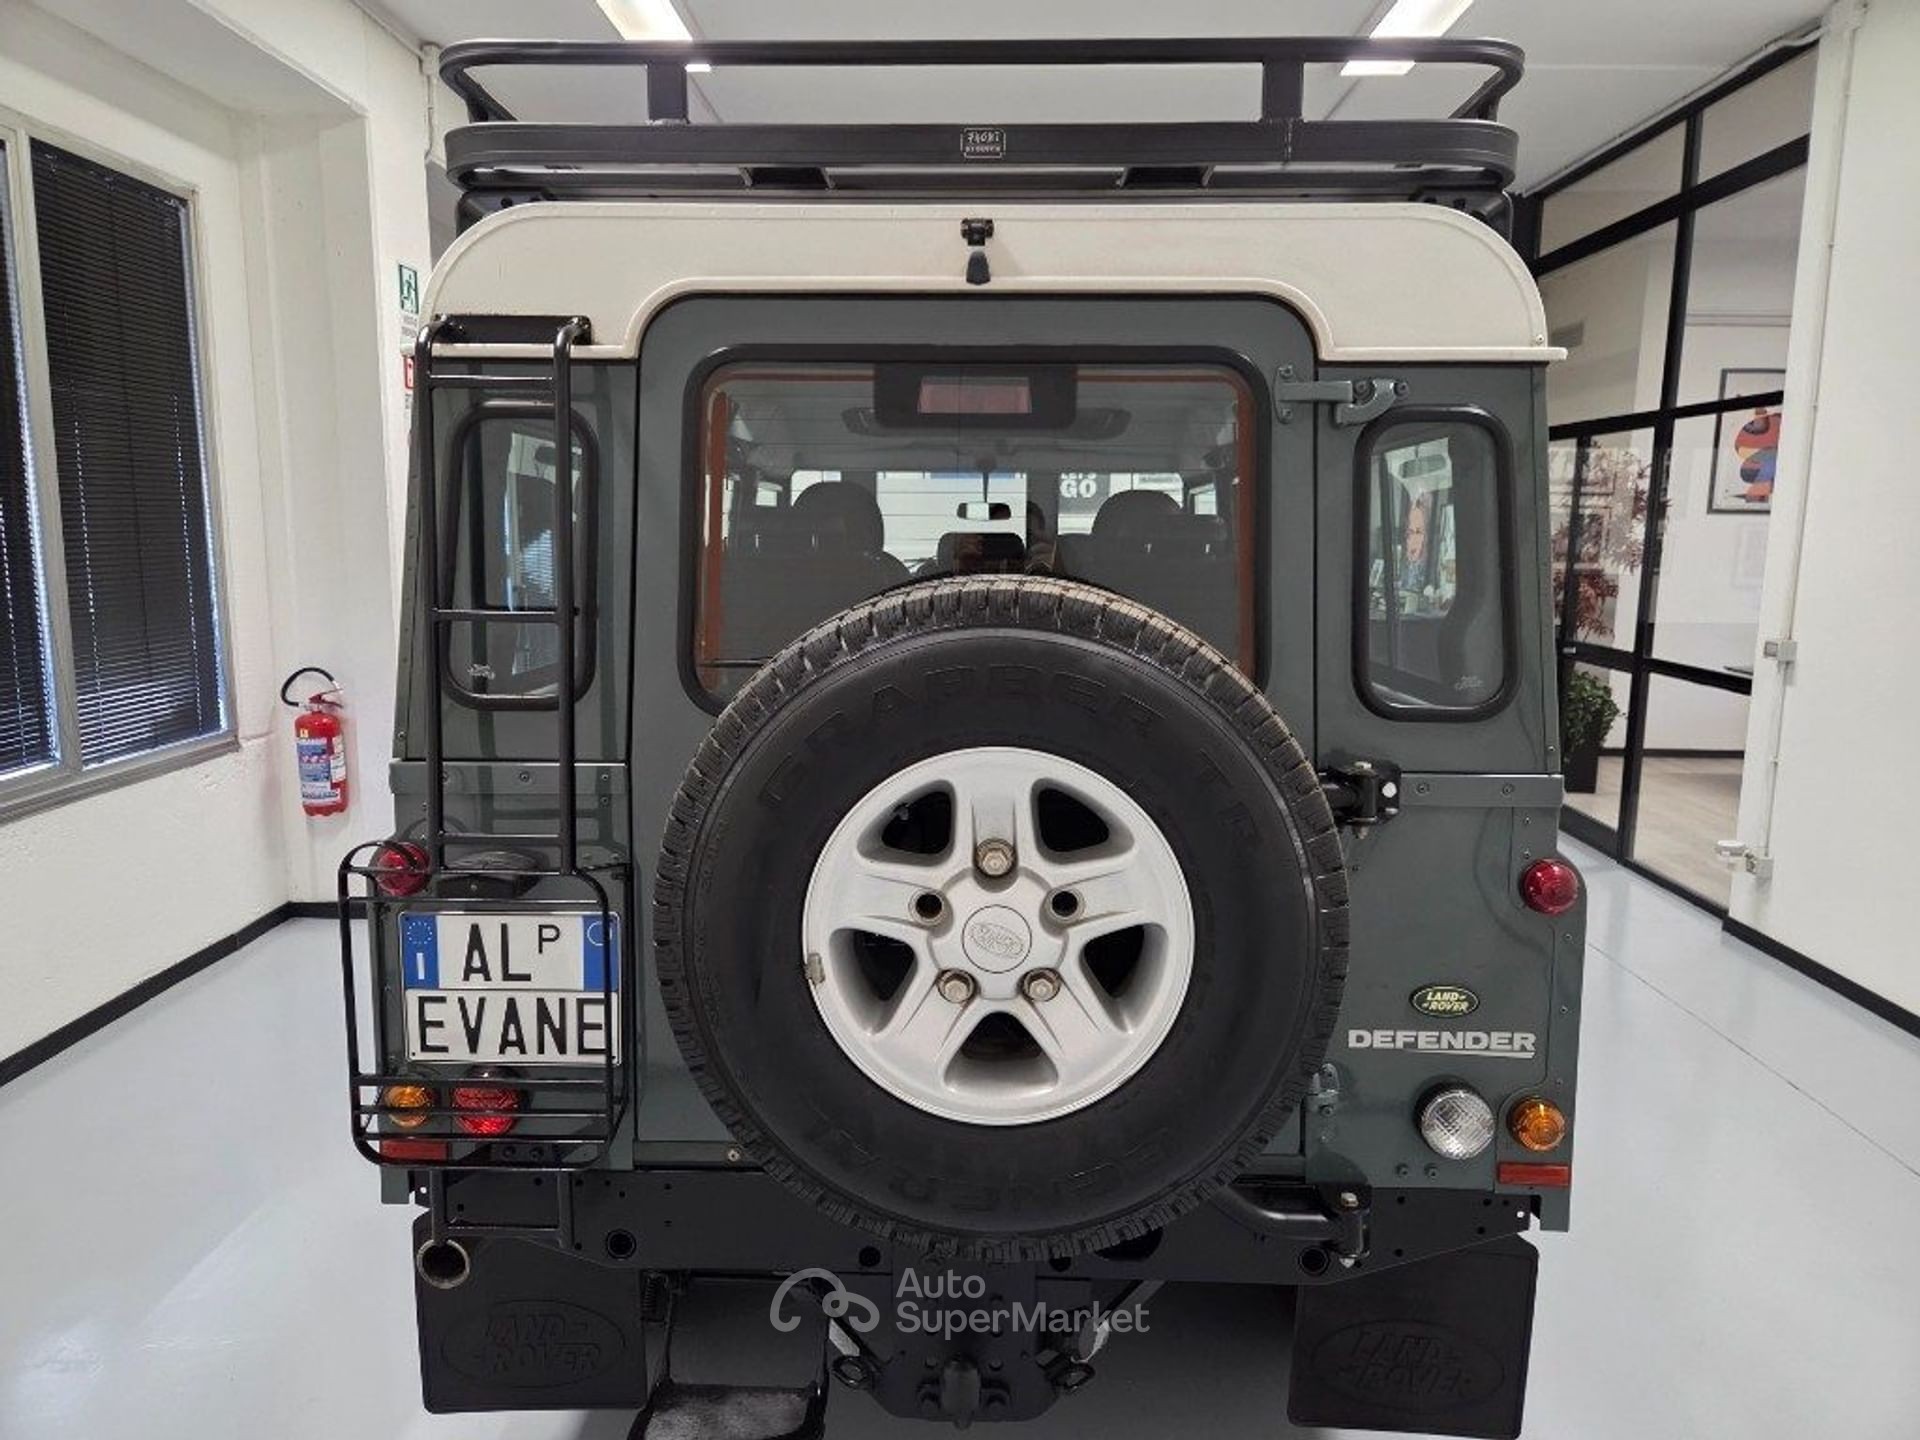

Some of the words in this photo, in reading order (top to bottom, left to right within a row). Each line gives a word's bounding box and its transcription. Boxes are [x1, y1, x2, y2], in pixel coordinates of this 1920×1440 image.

[1060, 479, 1097, 498] GO
[462, 923, 532, 982] AL
[538, 924, 561, 954] P
[1426, 992, 1461, 1001] LAND
[1428, 1001, 1469, 1012] ROVER
[417, 996, 609, 1055] EVANE
[1348, 1030, 1536, 1051] DEFENDER
